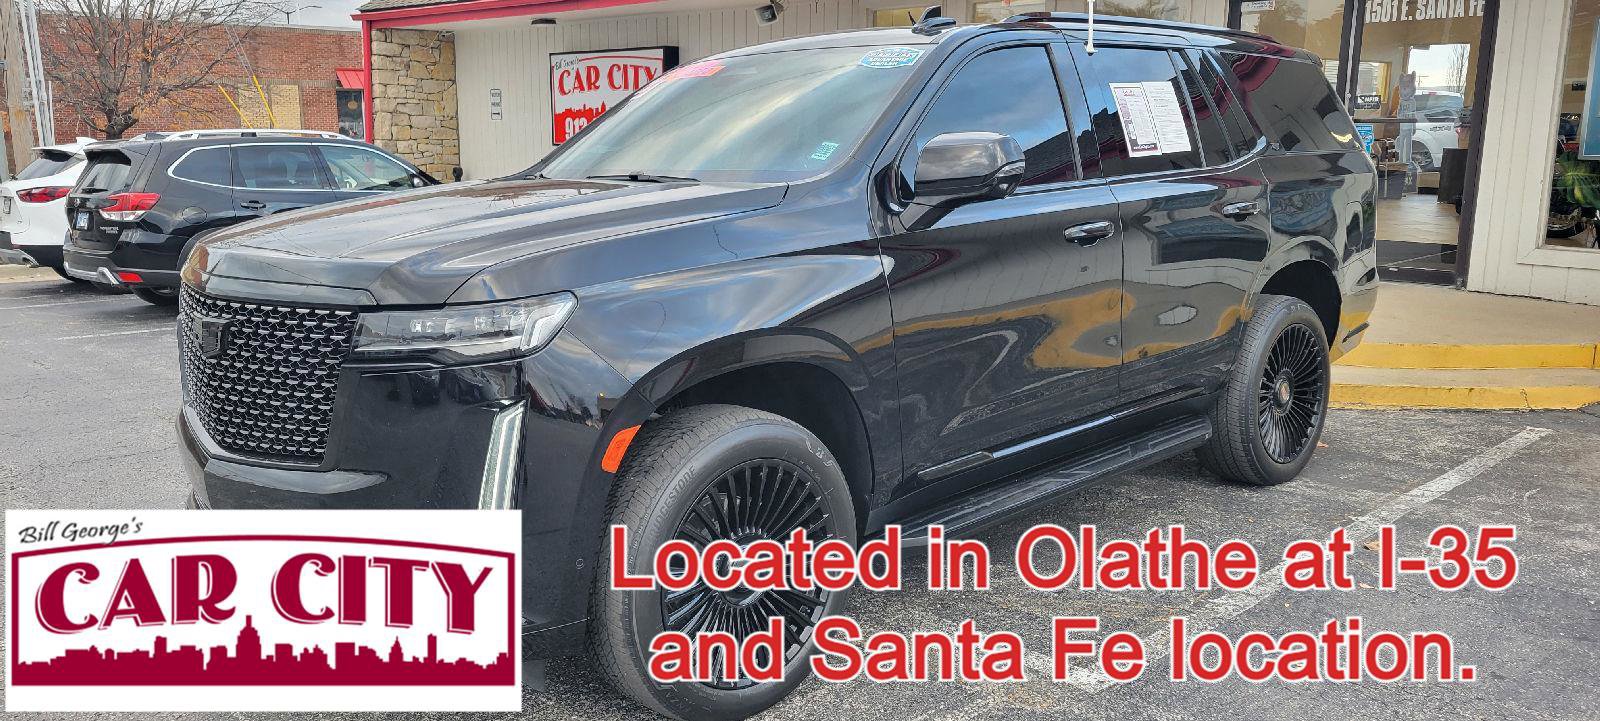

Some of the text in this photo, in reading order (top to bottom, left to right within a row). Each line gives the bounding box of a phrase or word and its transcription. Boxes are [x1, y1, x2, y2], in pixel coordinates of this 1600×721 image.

[1365, 0, 1399, 23] 1501
[558, 64, 600, 96] CAR
[607, 63, 657, 91] CITY
